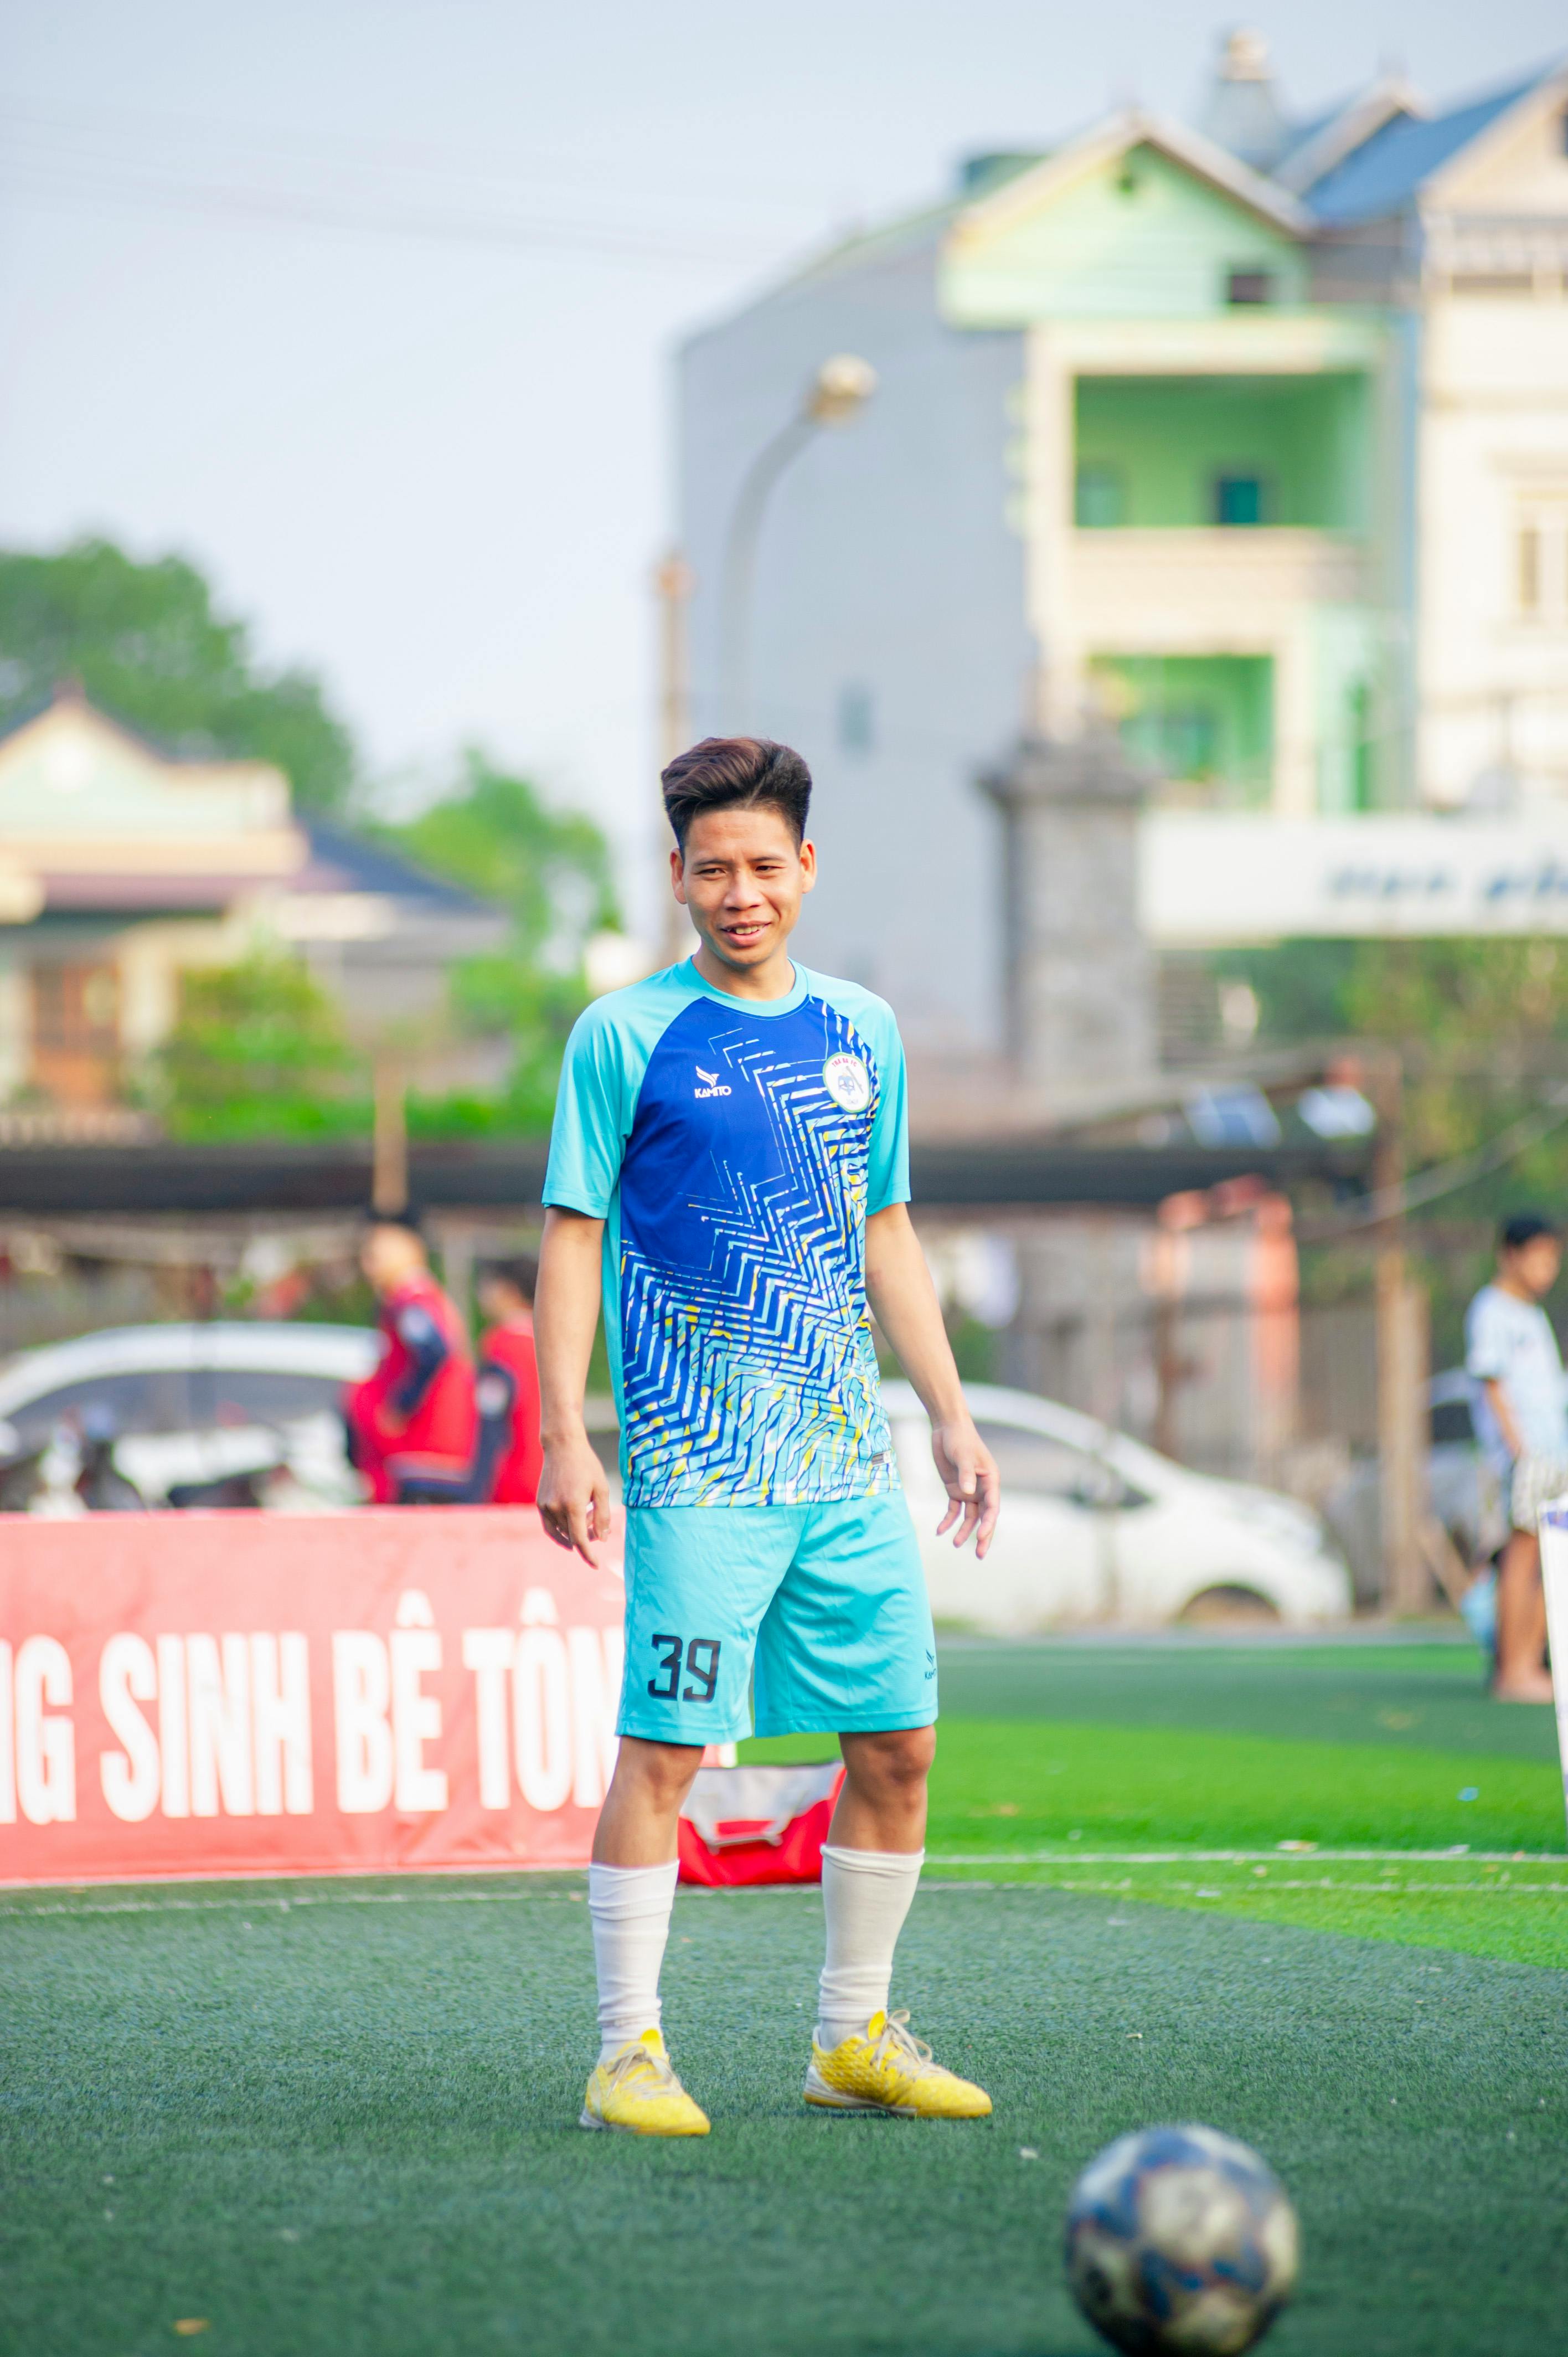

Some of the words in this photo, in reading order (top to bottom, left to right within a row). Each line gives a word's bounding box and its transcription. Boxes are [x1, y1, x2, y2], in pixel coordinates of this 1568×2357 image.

[694, 1085, 732, 1098] KAMITO
[647, 1634, 721, 1704] 39
[99, 1631, 314, 1822] SINH
[332, 1589, 449, 1814] BÊ
